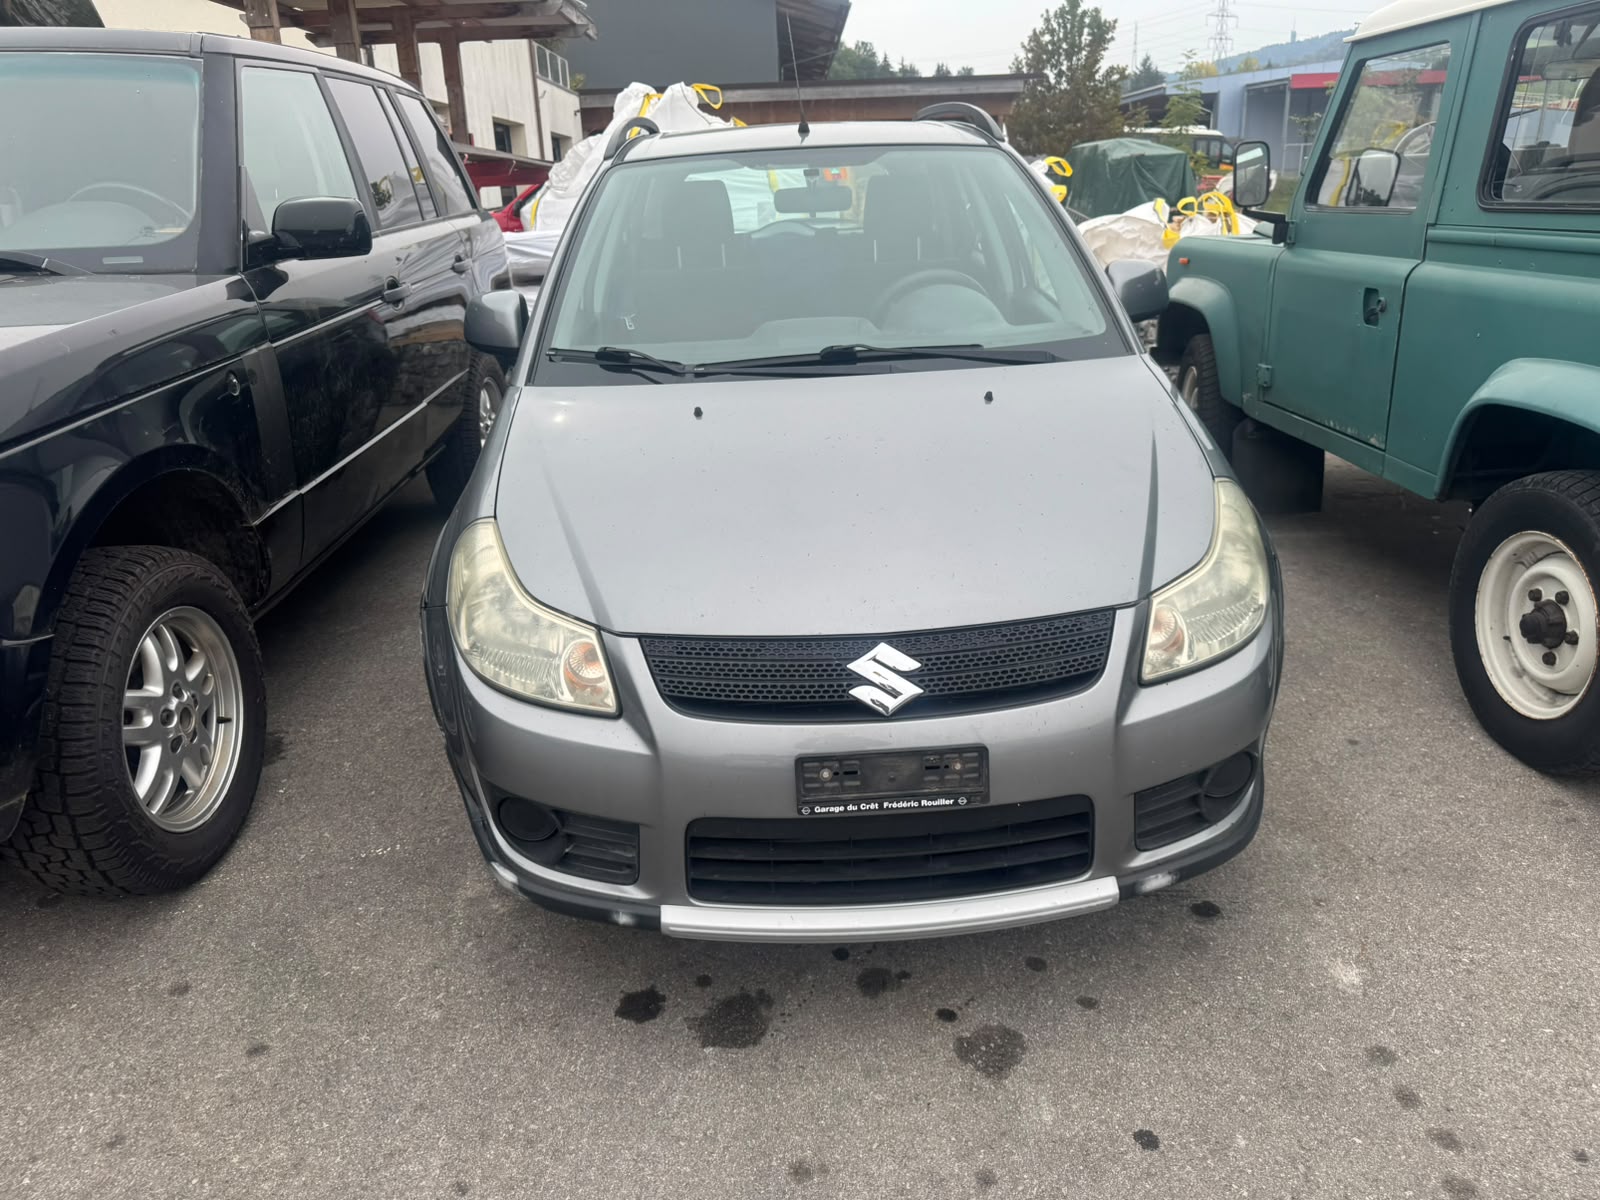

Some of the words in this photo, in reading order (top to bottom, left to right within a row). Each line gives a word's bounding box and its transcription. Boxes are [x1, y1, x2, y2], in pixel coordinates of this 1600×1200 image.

[814, 805, 845, 814] Garage
[847, 803, 858, 811] du
[860, 802, 879, 810] Crêt
[883, 800, 919, 809] Frédéric
